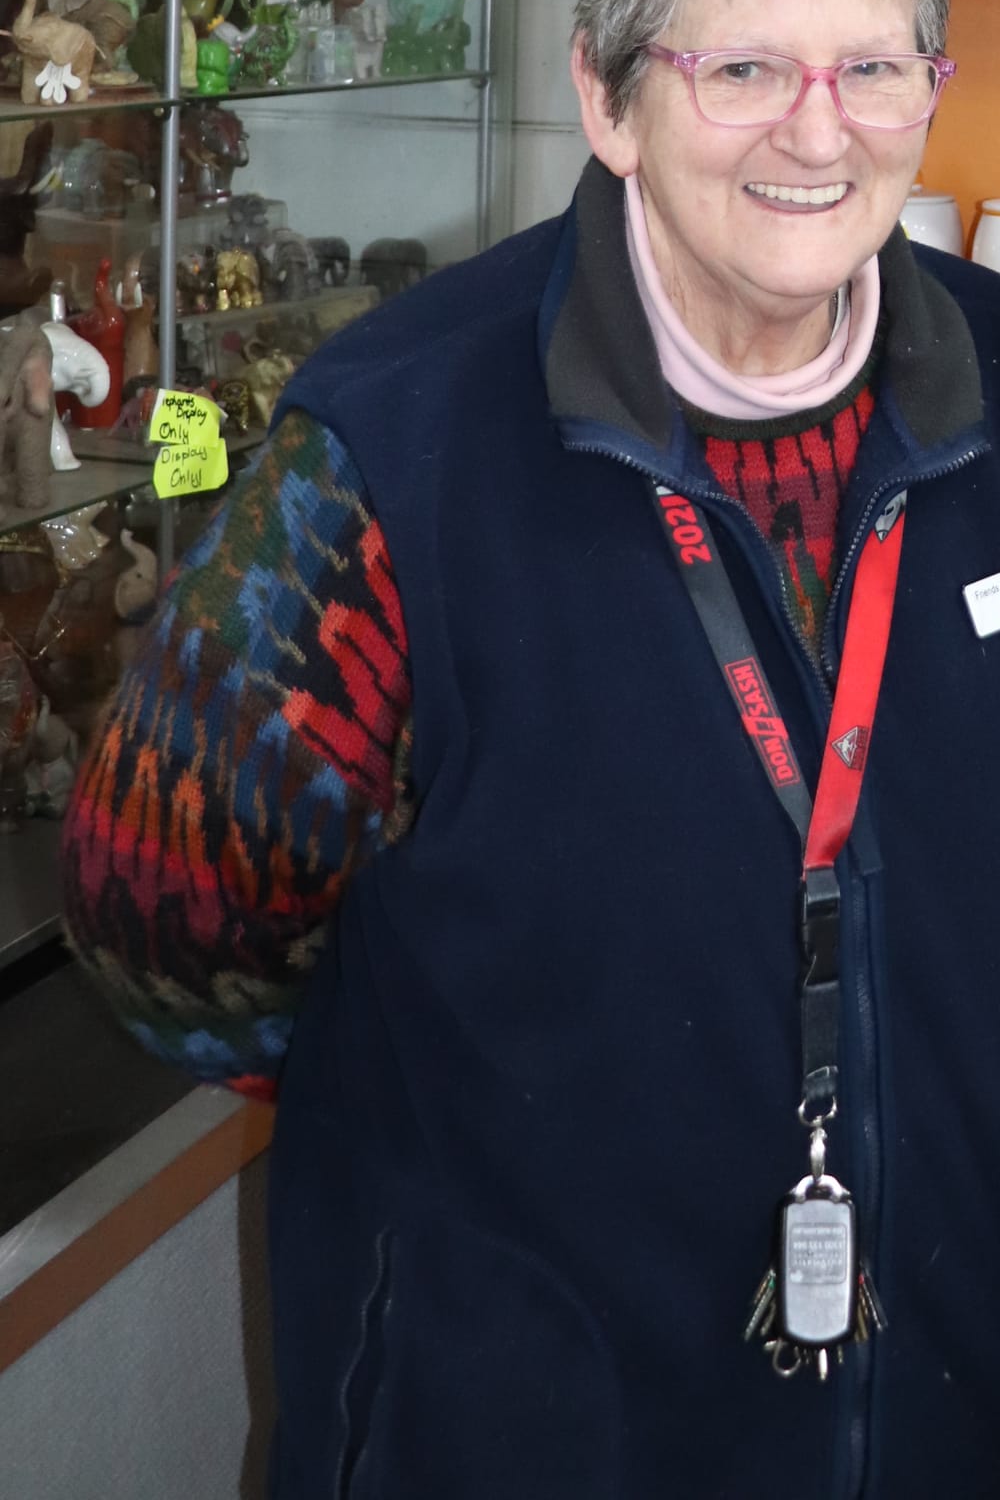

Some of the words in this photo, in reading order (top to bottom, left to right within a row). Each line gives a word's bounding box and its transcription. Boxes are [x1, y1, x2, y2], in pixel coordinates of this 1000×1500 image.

[159, 422, 189, 445] Only
[161, 446, 208, 465] Display
[660, 494, 712, 565] 2021
[732, 663, 769, 719] SASH
[762, 737, 793, 780] DON
